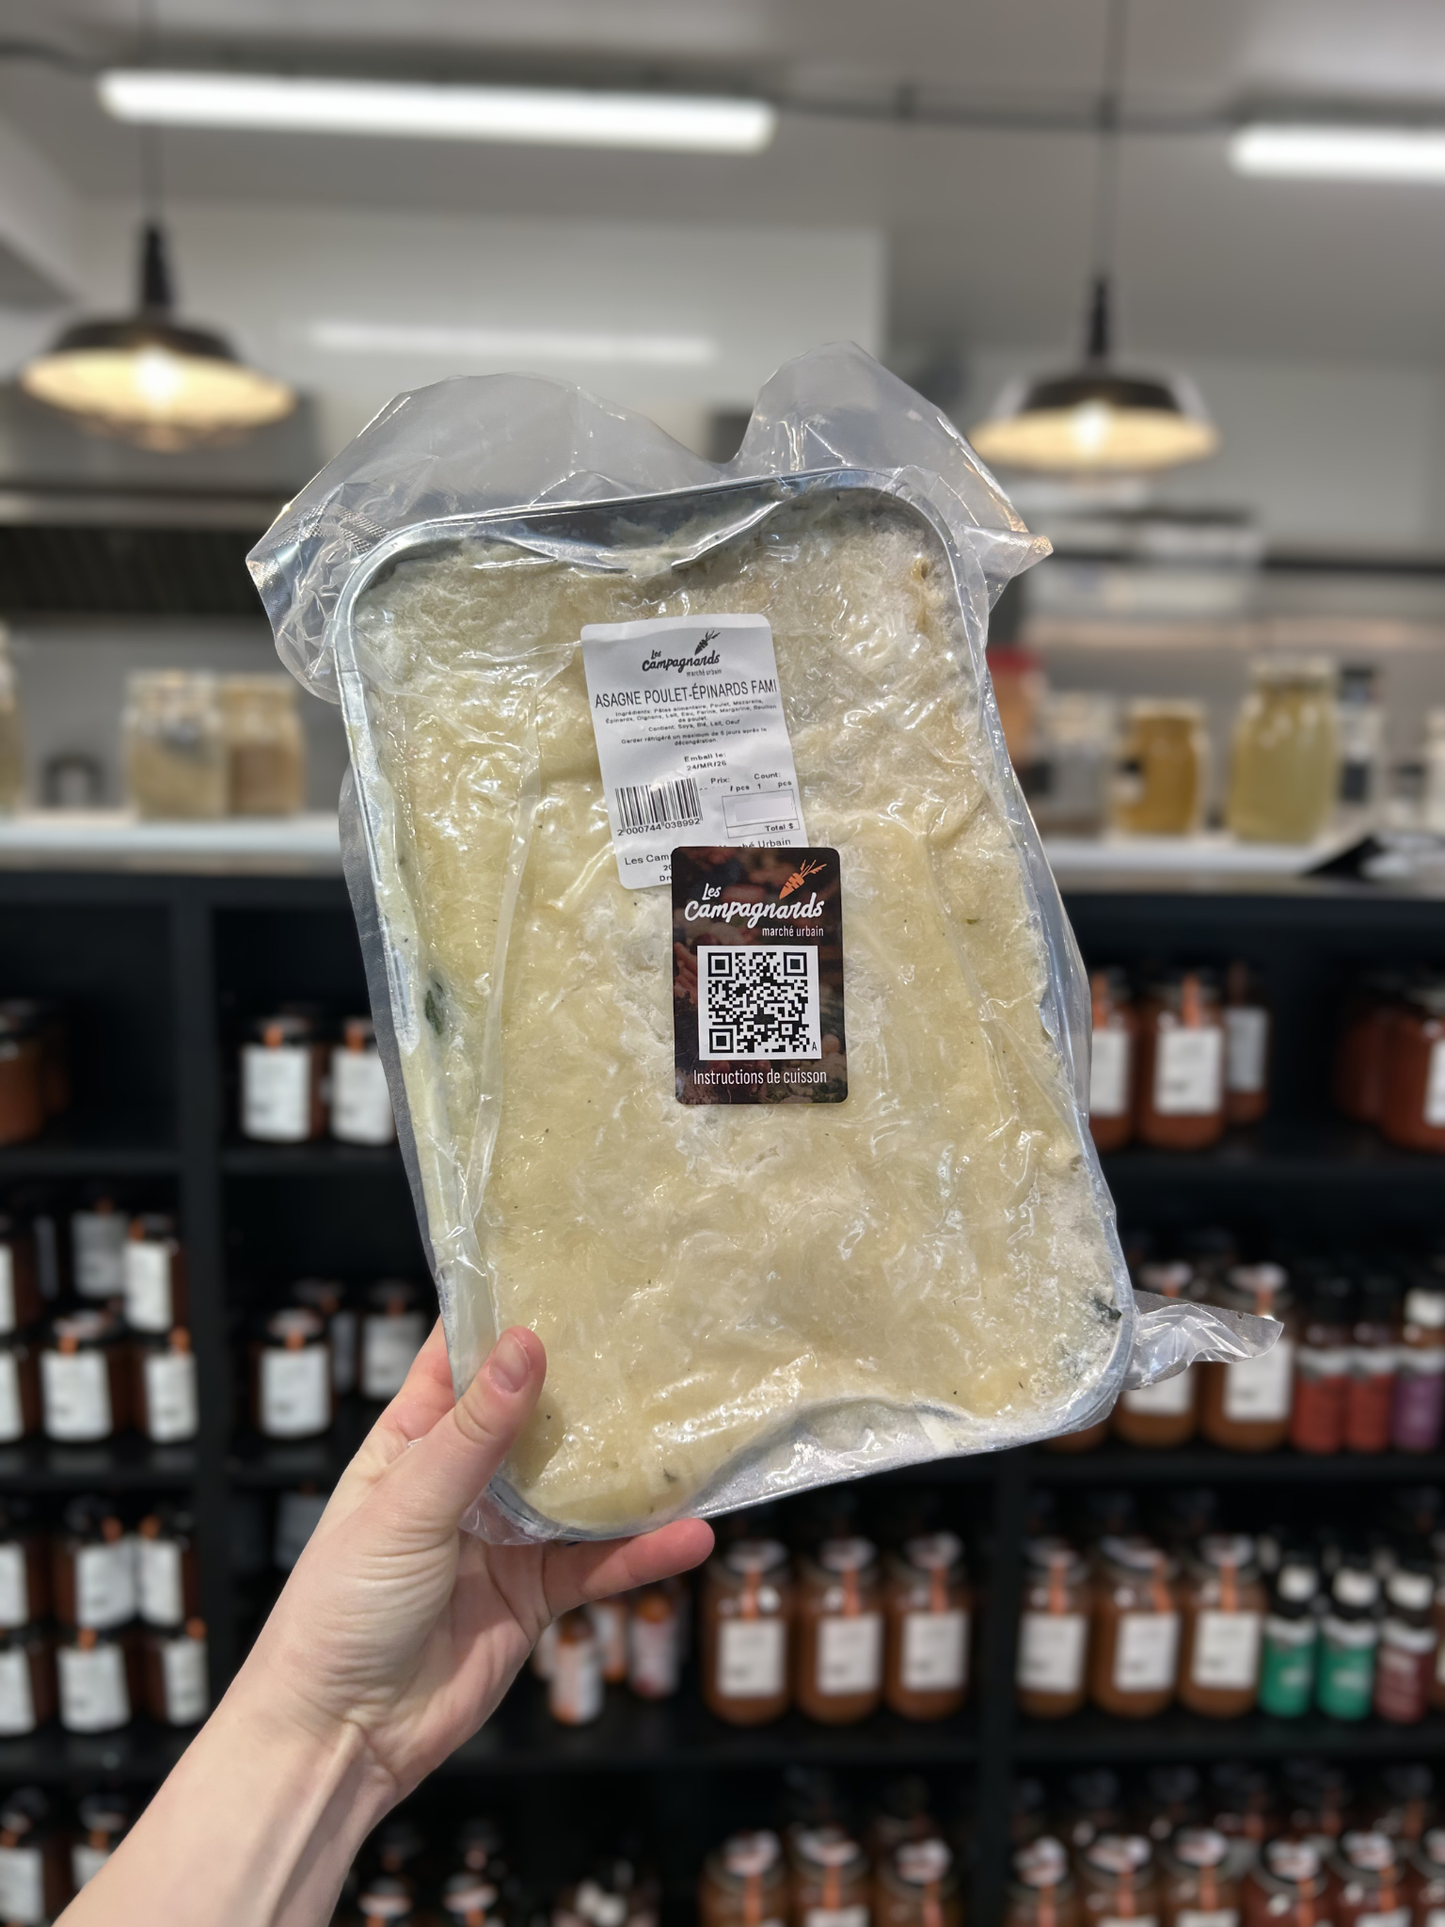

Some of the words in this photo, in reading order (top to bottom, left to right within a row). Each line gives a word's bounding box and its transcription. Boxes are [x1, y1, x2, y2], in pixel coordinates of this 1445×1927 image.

[650, 649, 662, 660] Les
[642, 650, 720, 674] Campagnards
[644, 682, 749, 704] POULET-ÉPINARDS
[751, 679, 778, 694] FAMI
[686, 760, 727, 771] 24/MR/26
[765, 824, 786, 832] Total
[624, 857, 644, 865] Les
[702, 883, 722, 900] Les
[684, 892, 825, 928] Campagnards
[762, 926, 794, 937] marché
[796, 925, 824, 936] urbain
[694, 1069, 764, 1085] Instructions
[766, 1068, 780, 1084] de
[783, 1068, 827, 1084] cuisson
